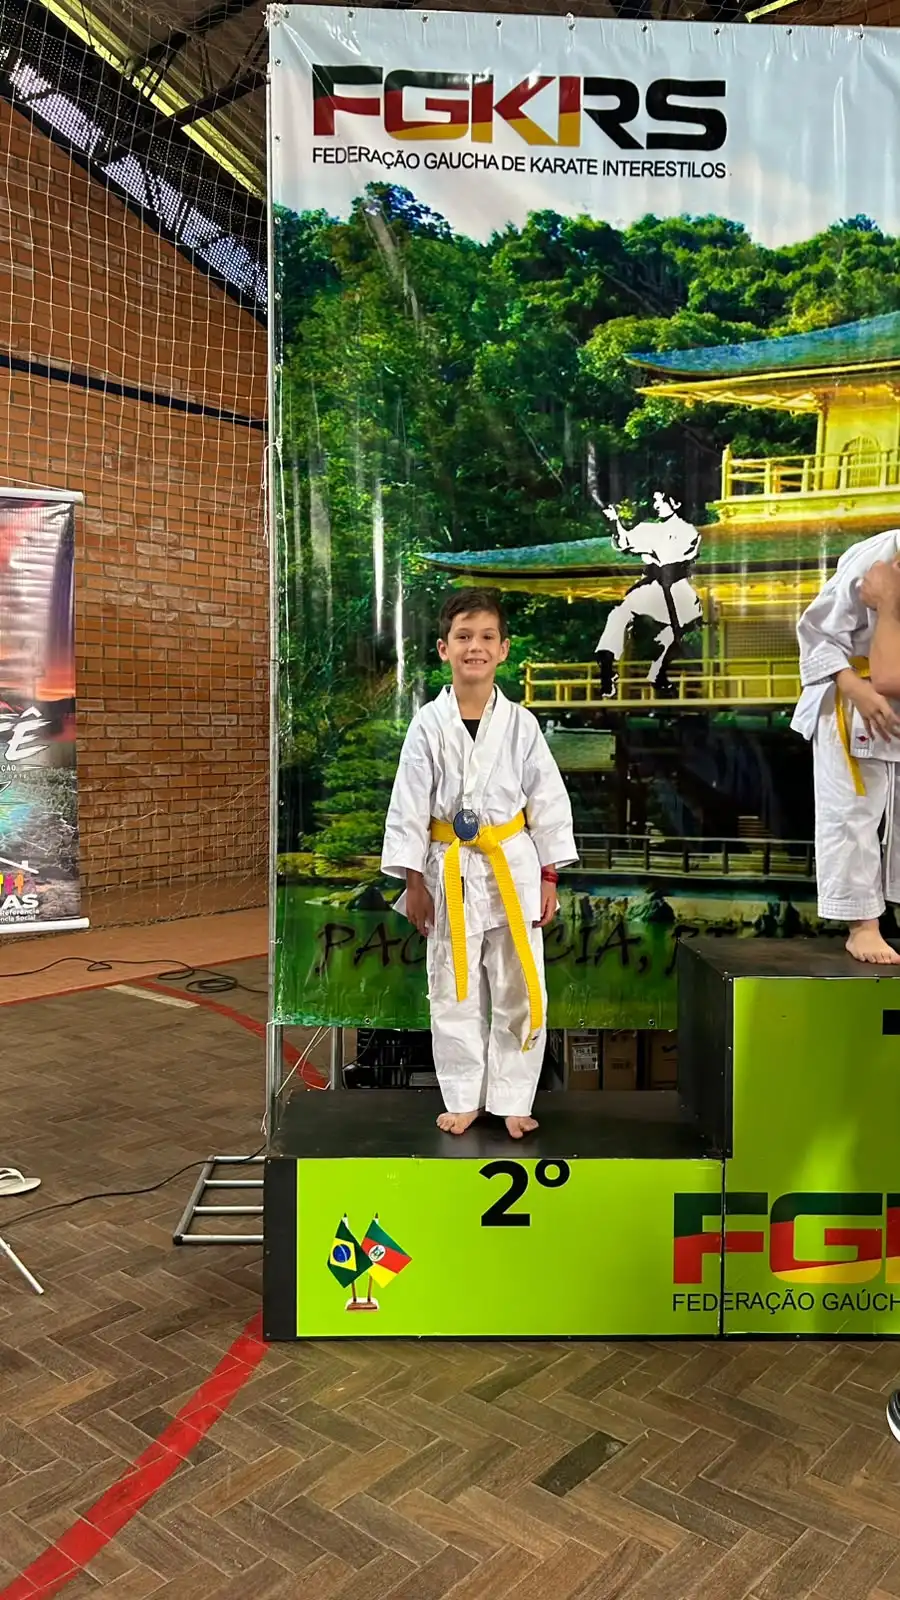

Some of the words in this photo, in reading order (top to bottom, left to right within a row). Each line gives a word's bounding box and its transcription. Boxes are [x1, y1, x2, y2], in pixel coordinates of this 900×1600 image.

[312, 64, 727, 151] FGKIRS
[312, 146, 420, 169] FEDERAÇÃO
[423, 152, 499, 170] GAUCHA
[501, 156, 526, 172] DE
[530, 157, 598, 175] KARATE
[602, 160, 726, 178] INTERESTILOS
[673, 1192, 900, 1284] FG
[672, 1289, 815, 1315] FEDERAÇÃO
